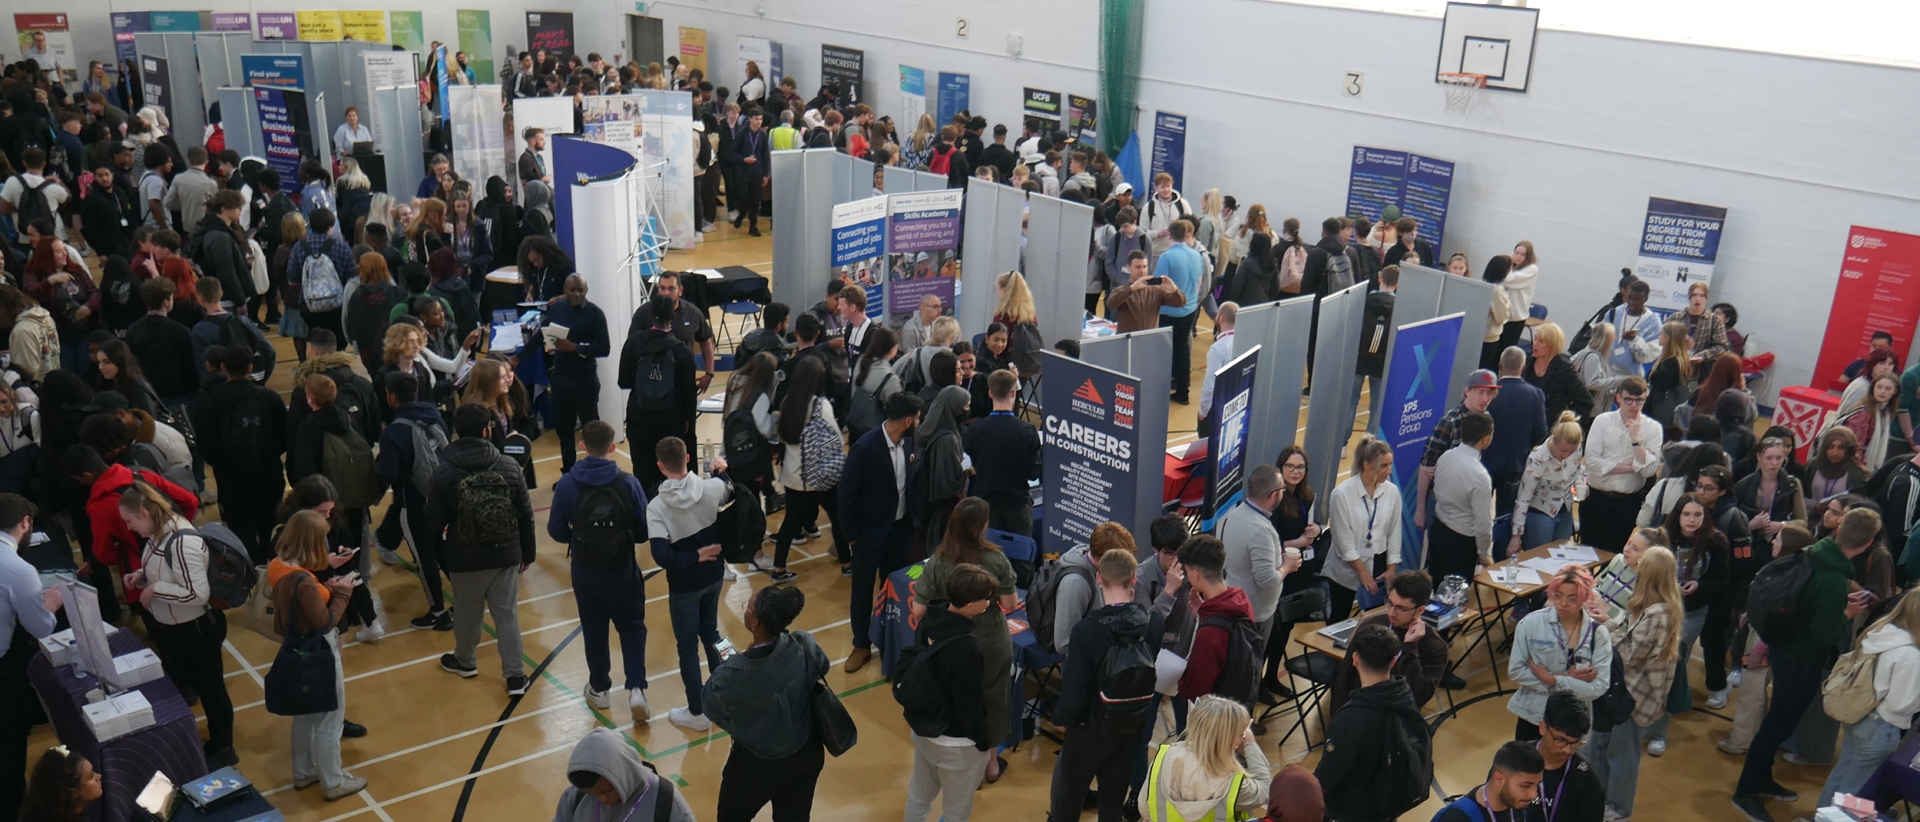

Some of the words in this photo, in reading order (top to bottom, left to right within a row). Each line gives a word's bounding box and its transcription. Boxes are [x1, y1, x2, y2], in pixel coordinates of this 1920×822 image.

[535, 29, 565, 40] MAKE
[957, 20, 966, 37] 2
[545, 38, 571, 48] REAL
[832, 51, 854, 59] UNIVERSITY
[823, 57, 860, 70] WINCHESTER
[1347, 73, 1361, 95] 3
[1033, 91, 1050, 102] UCFB
[260, 104, 278, 113] Power
[262, 122, 295, 133] Business
[271, 133, 291, 143] Bank
[268, 144, 299, 155] Account
[921, 210, 949, 218] Academy
[895, 223, 927, 232] Connecting
[1649, 215, 1676, 225] STUDY
[1677, 218, 1694, 227] FOR
[1696, 221, 1720, 231] YOUR
[837, 227, 866, 240] Connecting
[867, 225, 878, 235] you
[1647, 225, 1681, 236] DEGREE
[1682, 228, 1706, 238] FROM
[849, 239, 863, 249] world
[870, 233, 882, 245] jobs
[917, 239, 952, 247] construction
[1645, 234, 1664, 243] ONE
[1664, 236, 1677, 244] OF
[1678, 237, 1704, 248] THESE
[844, 246, 876, 260] construction
[649, 364, 662, 380] A
[1115, 382, 1135, 394] ONE
[1115, 390, 1135, 401] VISION
[1072, 399, 1105, 416] HERCULES
[1114, 397, 1134, 410] ONE
[1114, 404, 1134, 417] TEAM
[1224, 398, 1240, 419] COME
[1240, 392, 1247, 409] TO
[1402, 400, 1418, 414] XPS
[1114, 413, 1133, 426] ONE
[1400, 409, 1432, 425] Pensions
[1114, 420, 1133, 430] SOLUTION
[1398, 422, 1421, 436] Group
[1045, 414, 1131, 459] CAREERS
[1218, 410, 1246, 461] LIVE
[1045, 433, 1056, 446] IN
[1056, 438, 1130, 473] CONSTRUCTION
[1060, 464, 1080, 475] QUALITY
[1080, 472, 1113, 488] MANAGEMENT
[1071, 462, 1102, 478] RECRUITMENT
[1063, 476, 1083, 488] PROJECT
[1083, 485, 1109, 499] MANAGERS
[1079, 477, 1104, 491] ENGINEERS
[1060, 487, 1083, 500] QUANTITY
[1084, 497, 1110, 512] SURVEYORS
[1067, 484, 1079, 492] CIVIL
[1079, 489, 1104, 503] ENGINEERS
[1054, 503, 1083, 518] OPERATIONS
[1061, 499, 1077, 509] OFFICE
[1078, 506, 1109, 522] MANAGEMENT
[1073, 498, 1098, 512] ESTIMATOR
[1063, 523, 1076, 532] WORK
[1065, 518, 1093, 534] APPRENTICE
